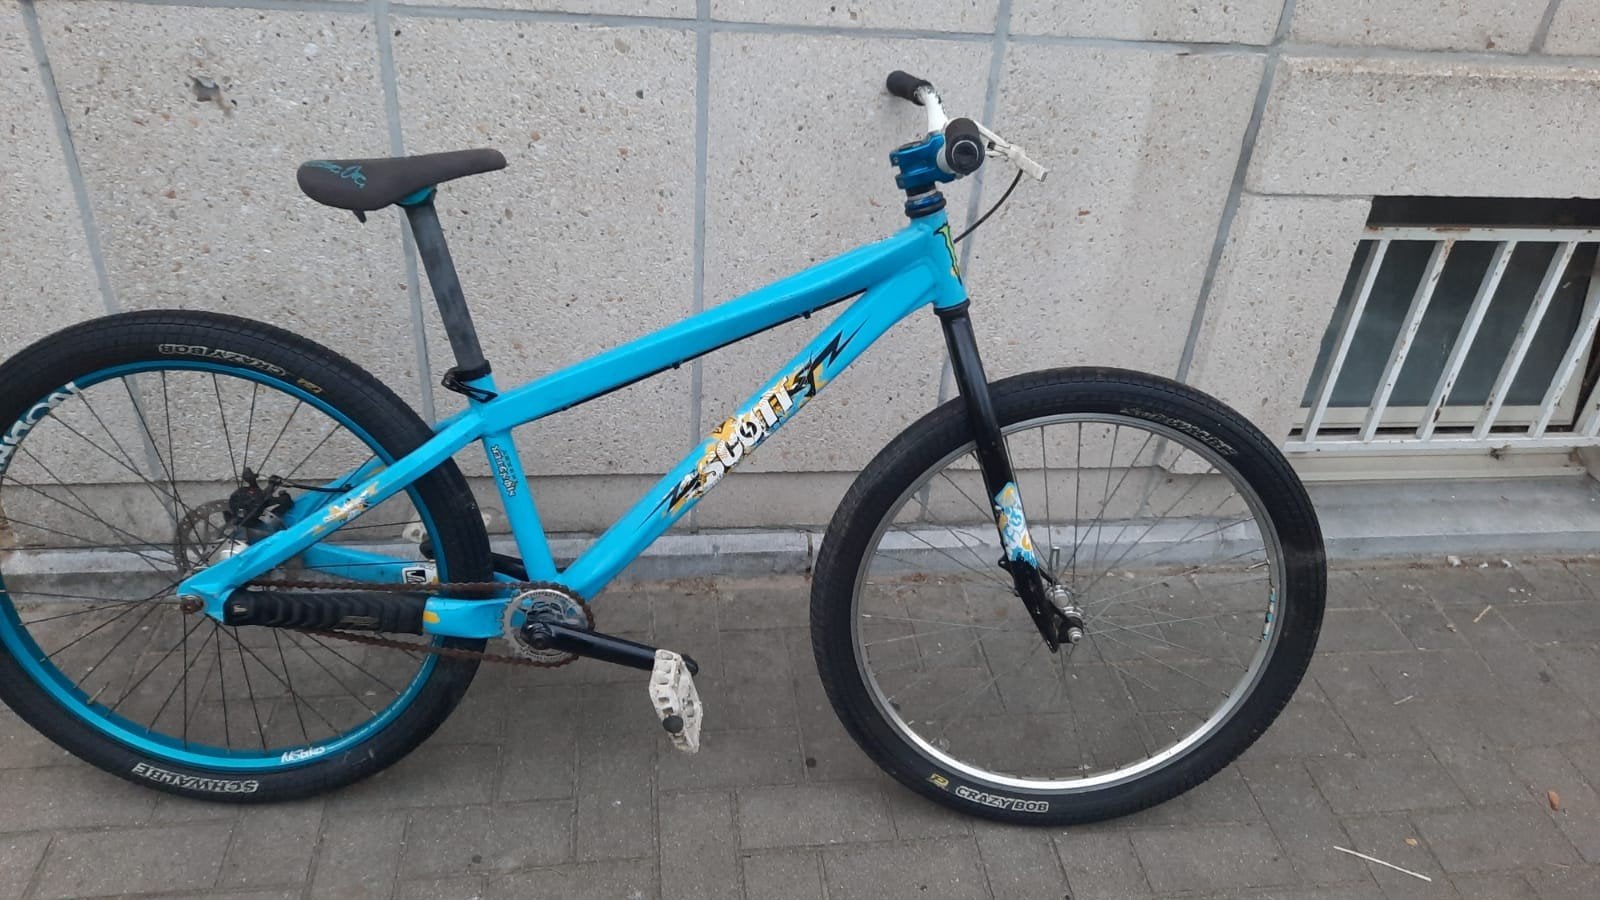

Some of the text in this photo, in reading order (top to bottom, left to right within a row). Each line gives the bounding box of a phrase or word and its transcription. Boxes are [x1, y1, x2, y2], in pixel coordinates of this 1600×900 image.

[695, 376, 793, 496] SCOTT
[131, 762, 260, 793] SCHWALBE
[955, 785, 1050, 813] CRAZY BOB
